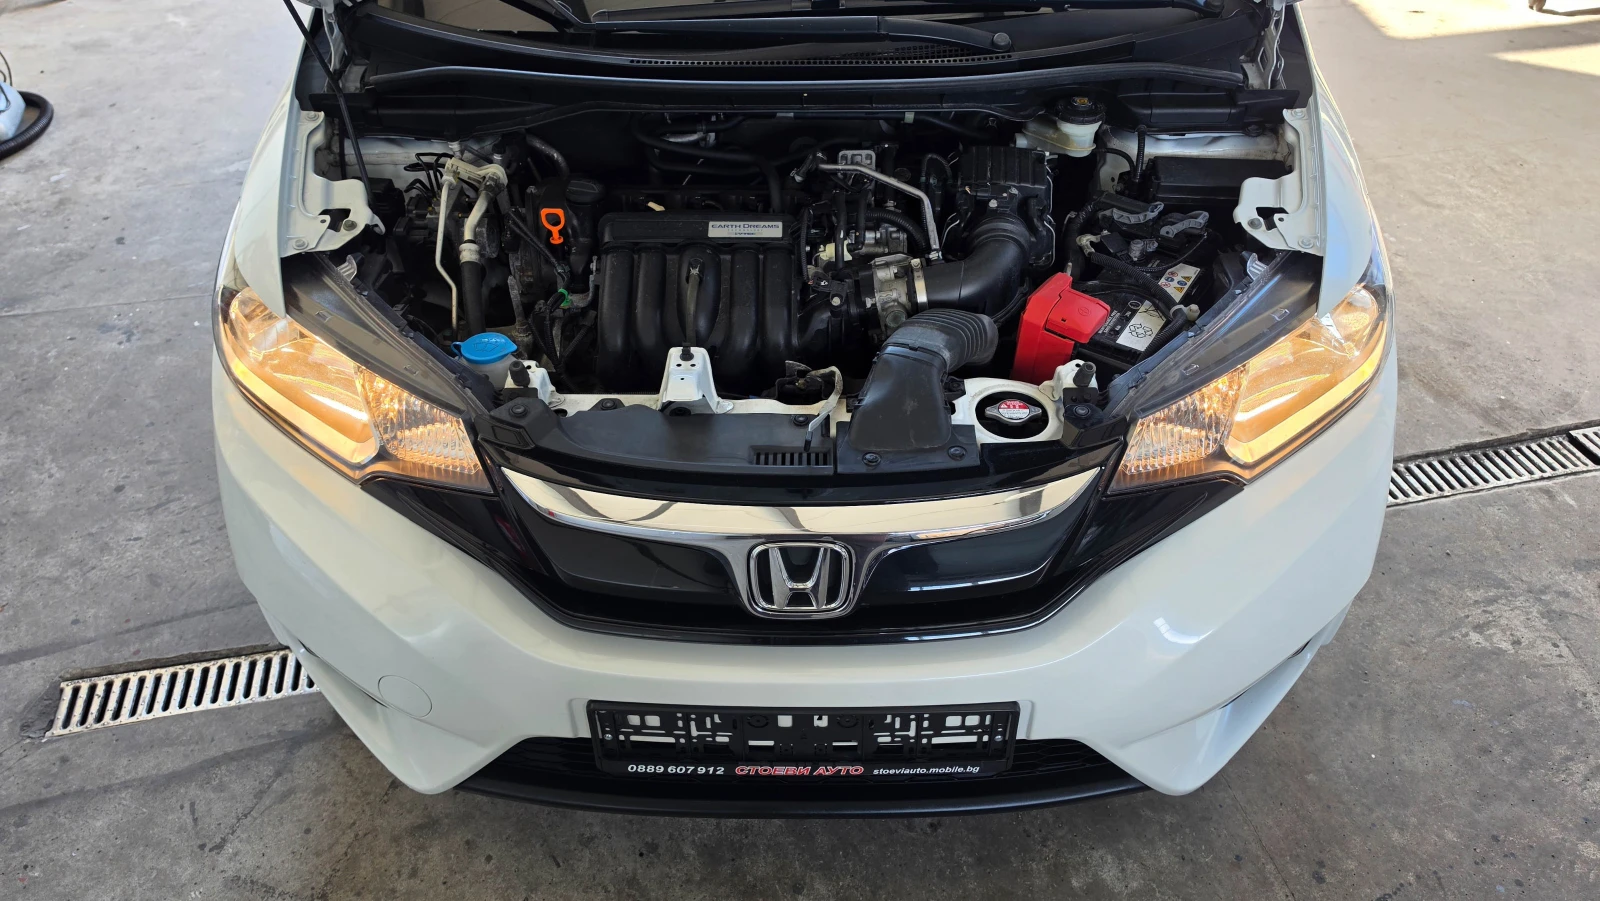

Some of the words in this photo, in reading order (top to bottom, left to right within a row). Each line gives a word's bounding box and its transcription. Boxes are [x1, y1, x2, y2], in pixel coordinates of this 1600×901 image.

[627, 764, 665, 773] 0889
[667, 765, 695, 774] 607
[697, 766, 725, 775] 912
[735, 765, 811, 776] СТОЕВИ
[813, 765, 865, 776] АУТО
[872, 765, 980, 775] stoeviauto.mobile.bg
